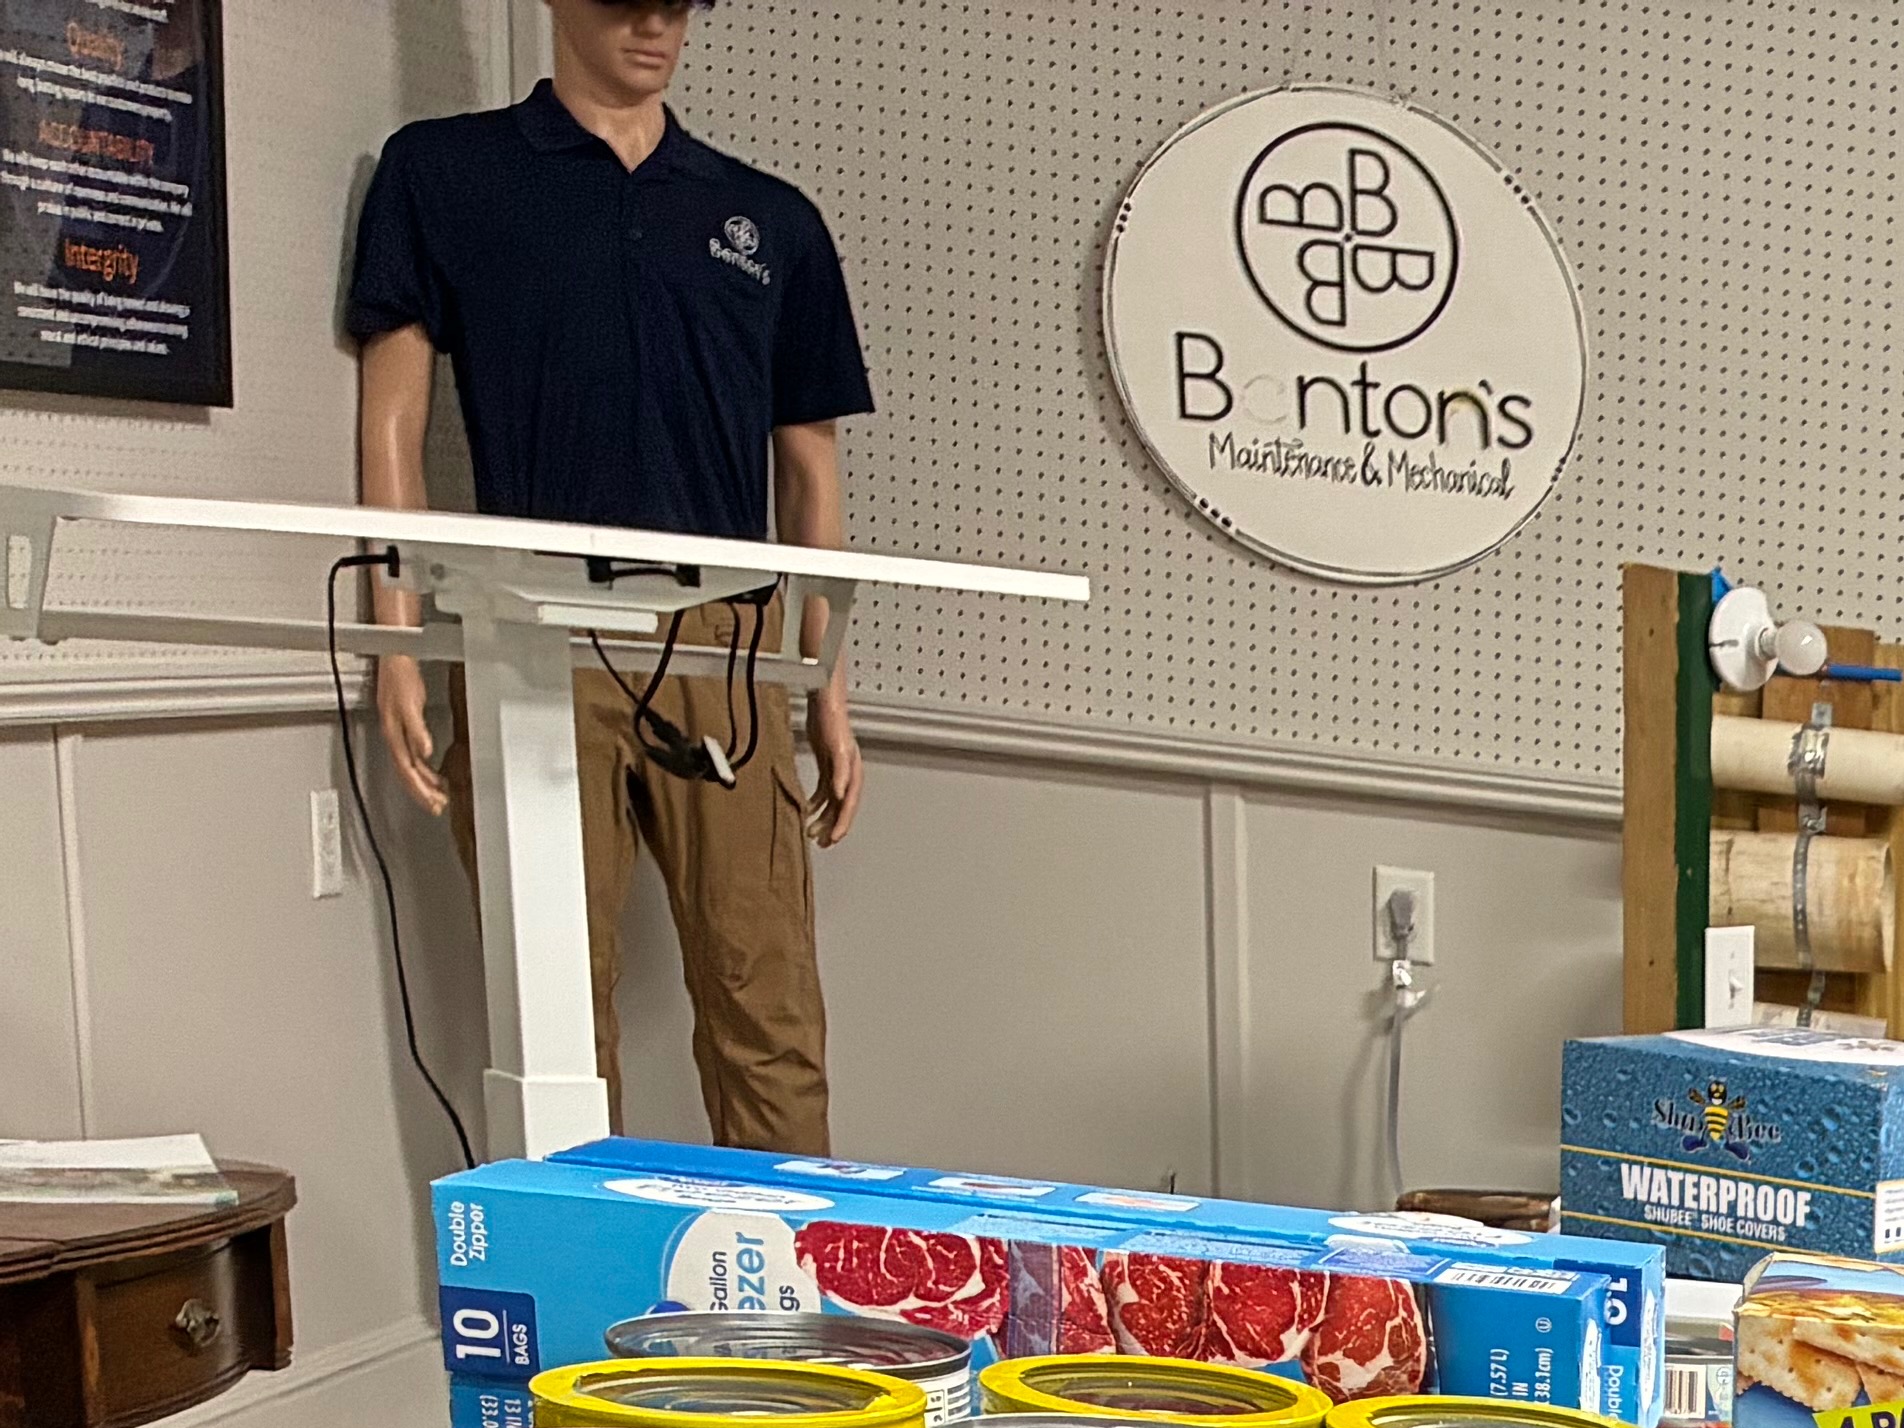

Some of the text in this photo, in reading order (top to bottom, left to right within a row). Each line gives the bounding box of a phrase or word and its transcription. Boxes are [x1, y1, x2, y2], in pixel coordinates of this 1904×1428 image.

[1209, 432, 1515, 500] Maintenance & Mechanical
[1621, 1163, 1812, 1227] WATERPROOF
[451, 1201, 466, 1267] Double
[469, 1203, 484, 1261] Zipper
[1701, 1212, 1733, 1234] SHOE
[1736, 1218, 1786, 1242] COVERS
[453, 1308, 500, 1361] 10
[512, 1323, 529, 1366] BAGS
